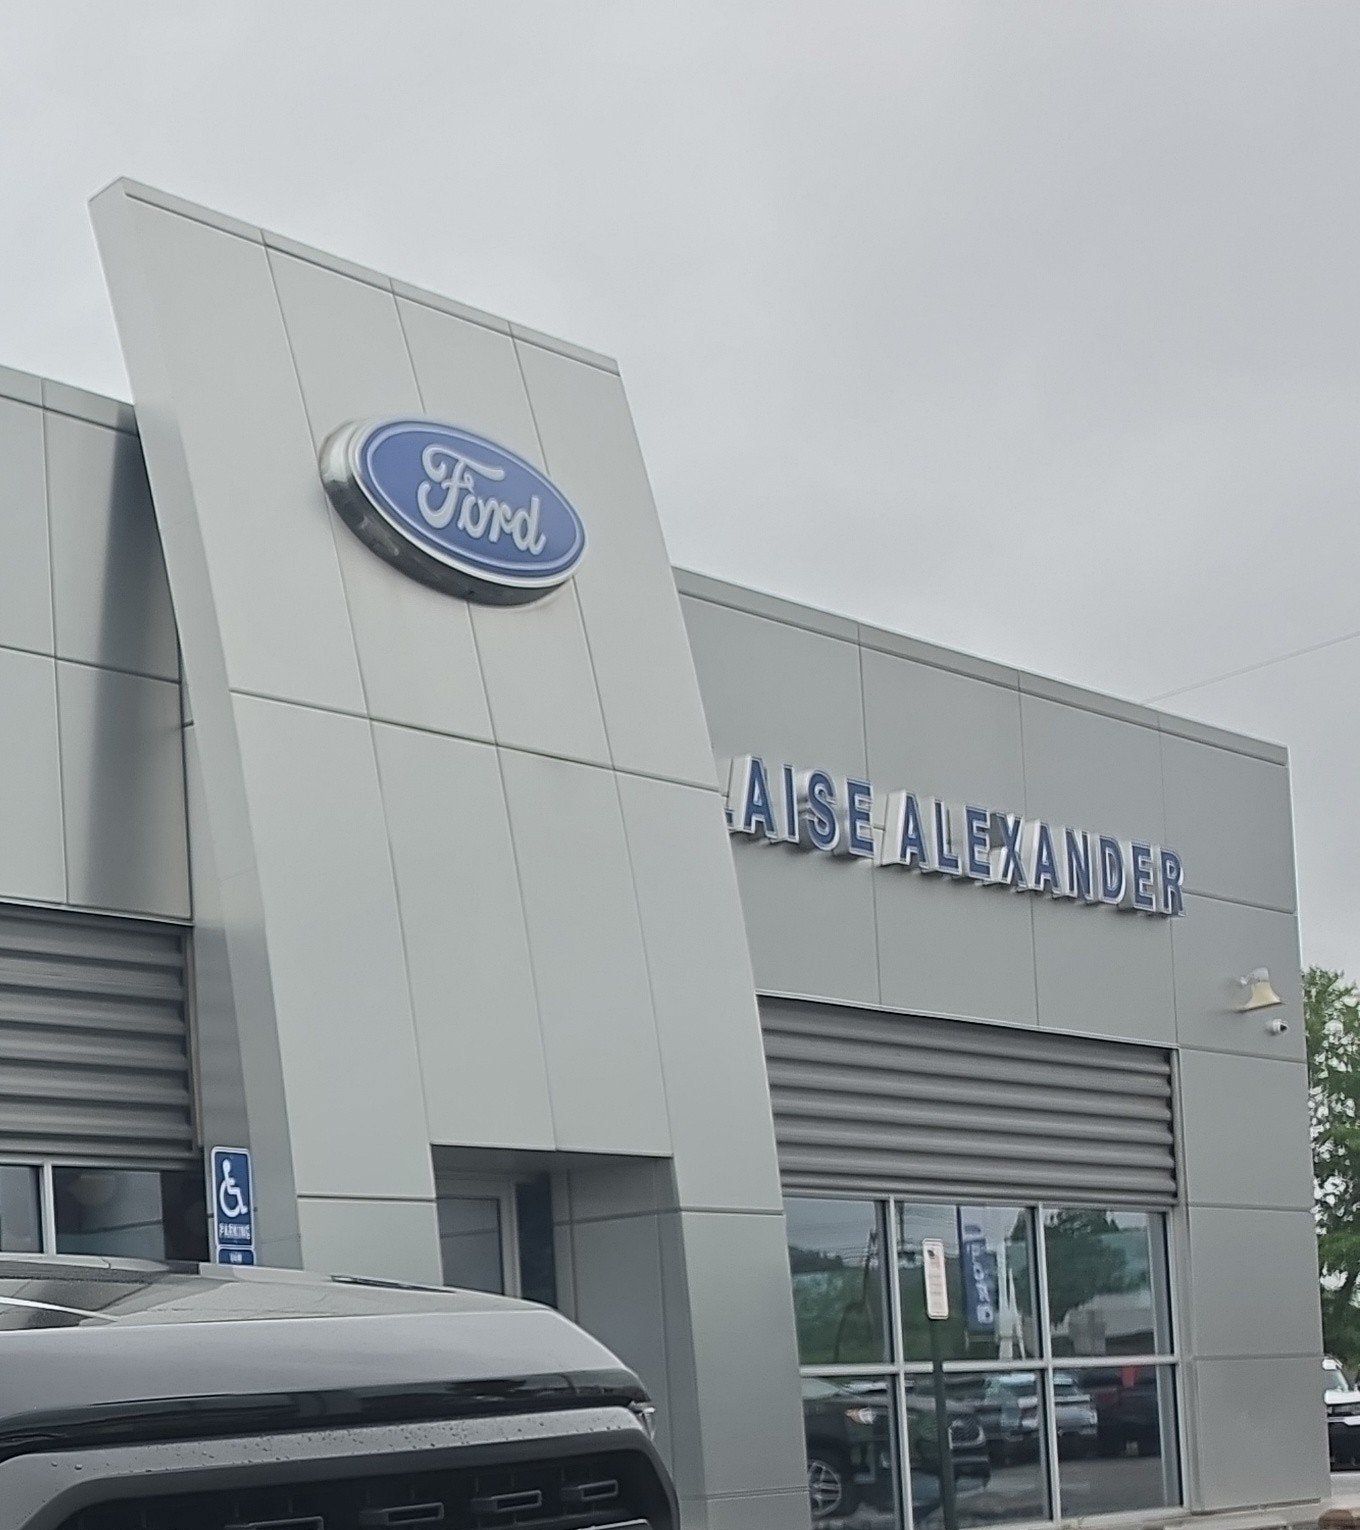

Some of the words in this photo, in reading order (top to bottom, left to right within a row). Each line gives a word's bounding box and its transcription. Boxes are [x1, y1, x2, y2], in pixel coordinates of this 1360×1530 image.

[417, 443, 546, 555] Ford
[726, 754, 875, 857] AISE
[883, 789, 1185, 916] ALEXANDER
